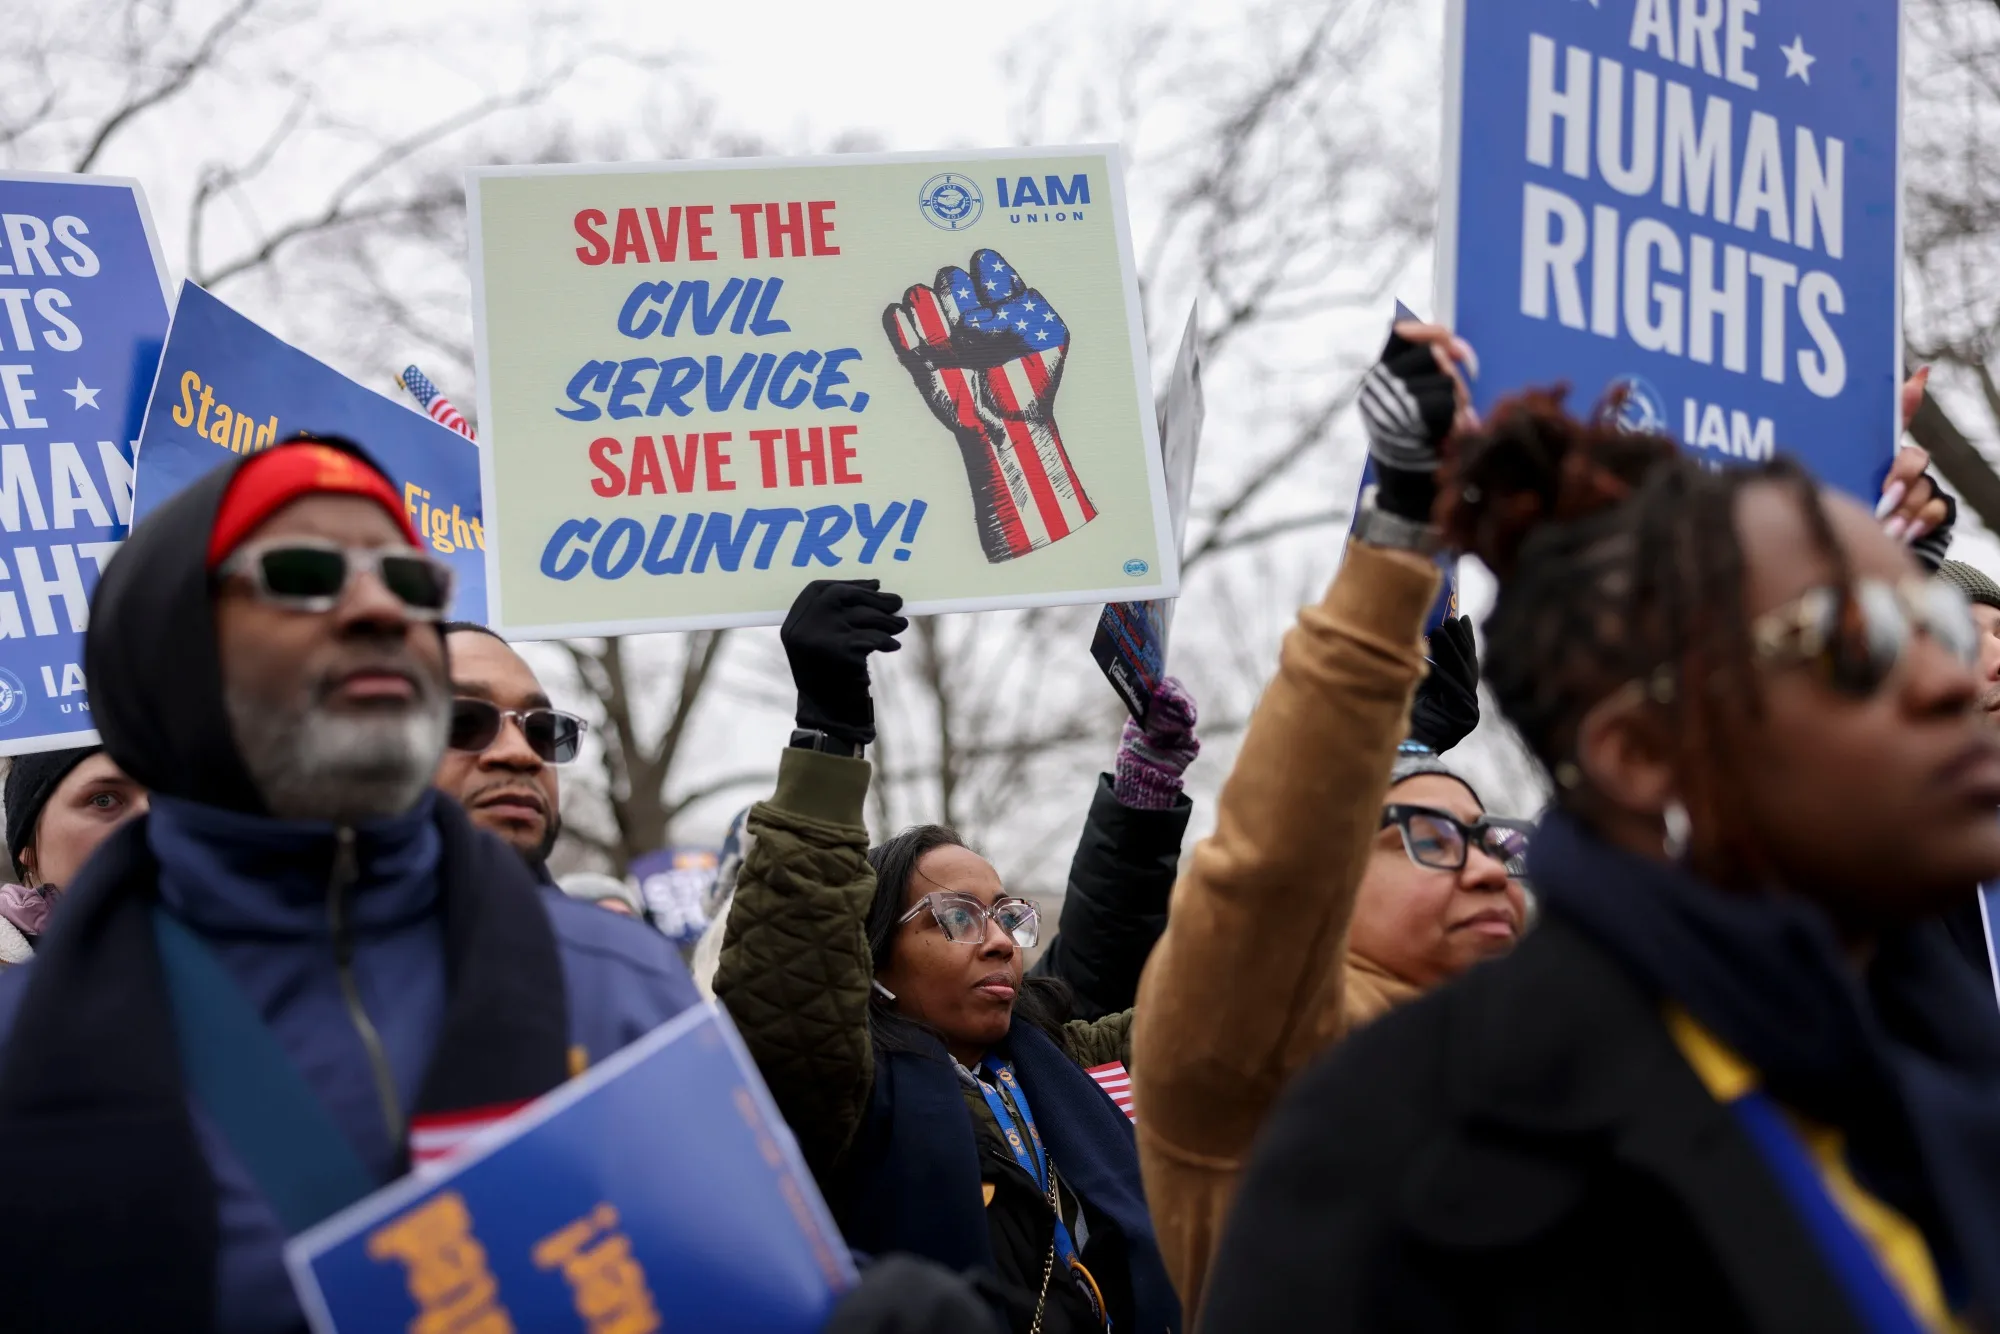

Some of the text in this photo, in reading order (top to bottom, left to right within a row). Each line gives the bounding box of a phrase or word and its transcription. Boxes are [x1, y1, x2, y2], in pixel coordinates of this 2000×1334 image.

[1629, 0, 1760, 91] ARE
[1526, 32, 1844, 260] HUMAN
[996, 174, 1091, 208] IAM
[1010, 211, 1084, 223] UNION
[574, 200, 841, 266] SAVE THE
[617, 277, 792, 340] CIVIL
[1520, 182, 1846, 398] RIGHTS
[173, 370, 278, 455] Stand
[555, 347, 870, 422] SERVICE,
[588, 424, 863, 499] SAVE THE
[1684, 397, 1774, 462] IAM
[404, 481, 486, 554] Fight
[540, 499, 928, 581] COUNTRY!
[40, 662, 88, 698] IA
